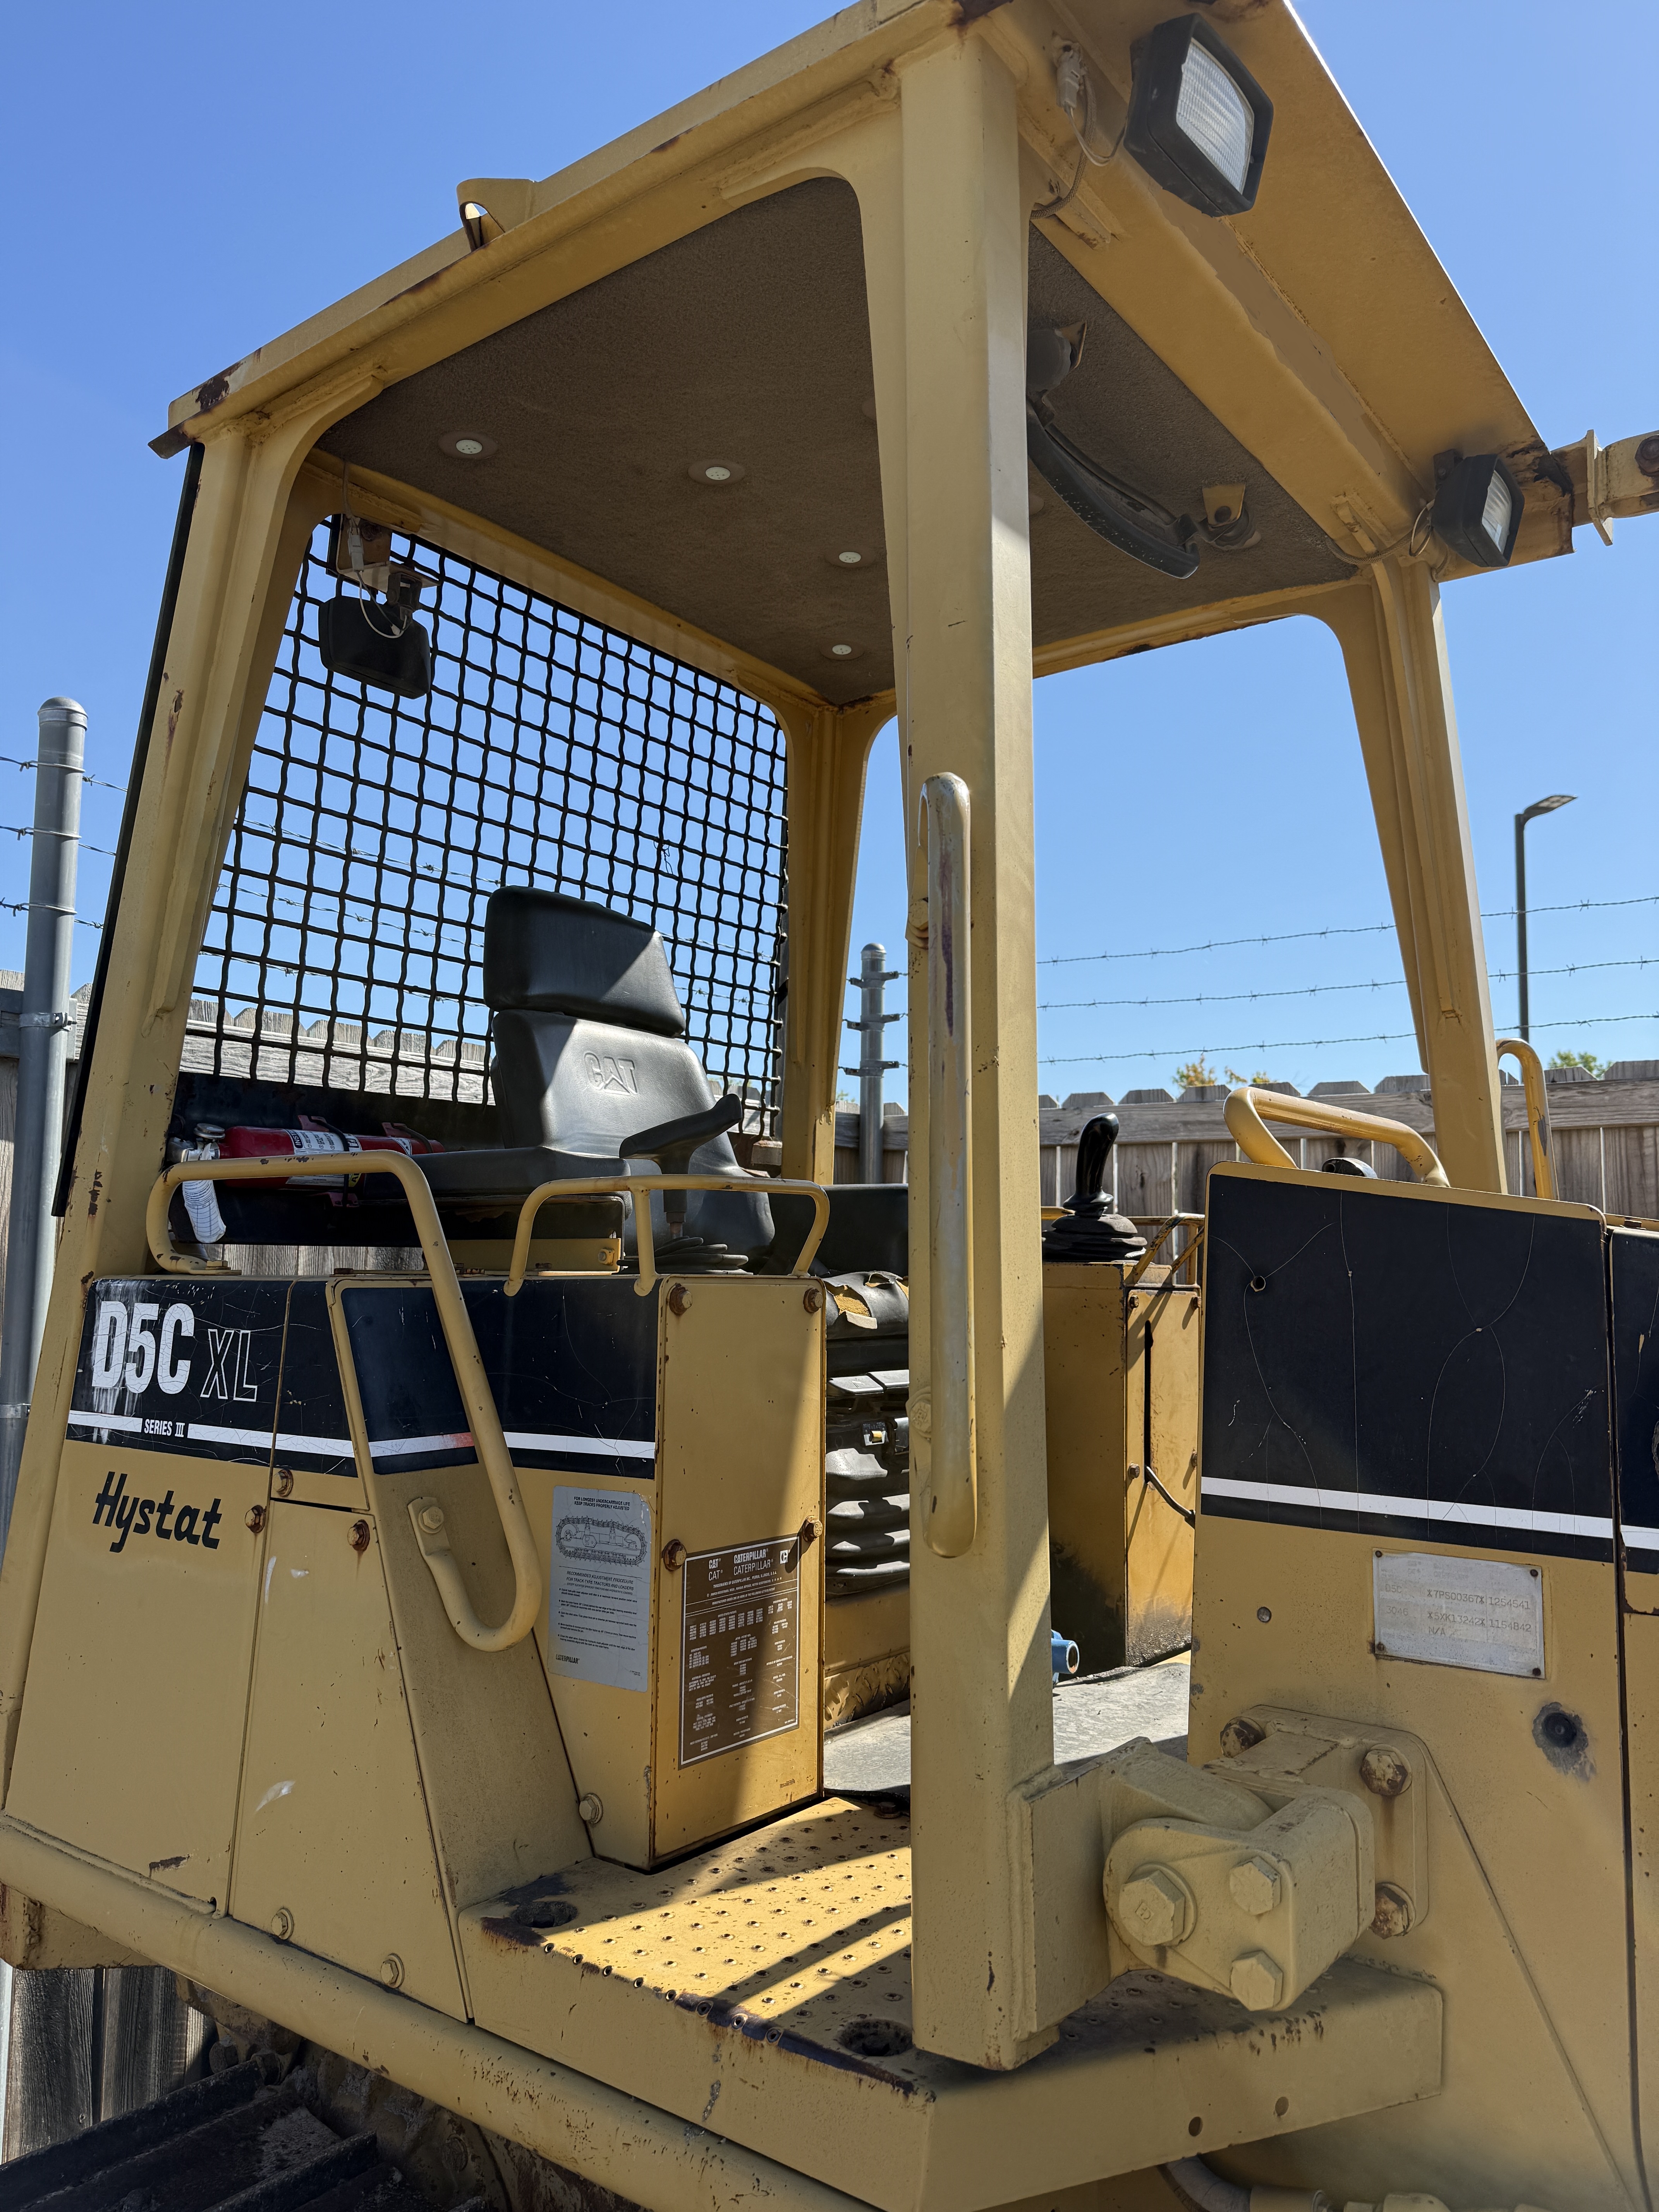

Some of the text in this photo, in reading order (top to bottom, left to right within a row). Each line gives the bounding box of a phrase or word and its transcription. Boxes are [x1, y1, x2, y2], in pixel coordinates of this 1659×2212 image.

[584, 1052, 637, 1096] CAT
[92, 1301, 258, 1402] D5C XL
[144, 1419, 185, 1437] SERIES III
[93, 1472, 222, 1553] Hystat
[1385, 1584, 1402, 1594] D5C
[1488, 1596, 1530, 1609] 1254541
[1386, 1606, 1408, 1616] 3046
[1429, 1626, 1446, 1637] N/A
